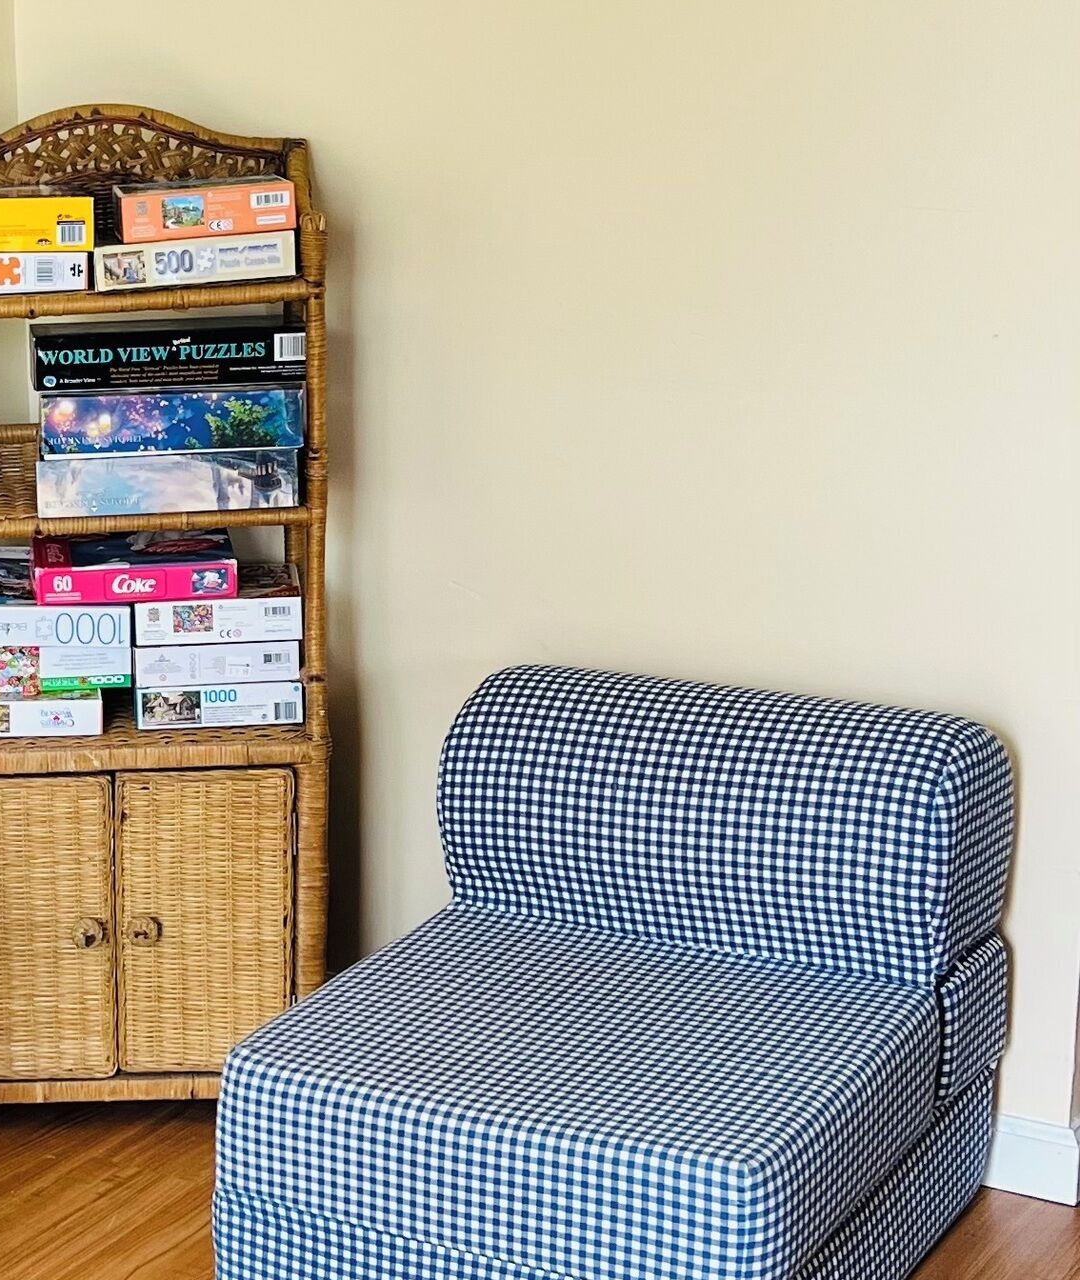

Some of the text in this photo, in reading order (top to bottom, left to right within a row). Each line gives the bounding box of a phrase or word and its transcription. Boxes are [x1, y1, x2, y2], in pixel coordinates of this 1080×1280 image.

[154, 249, 194, 274] 500
[38, 342, 266, 366] WORLD VIEW PUZZLES
[53, 575, 73, 592] 60
[111, 574, 157, 594] Coke
[55, 612, 125, 645] 1000
[87, 675, 125, 685] 1000
[203, 689, 237, 703] 1000
